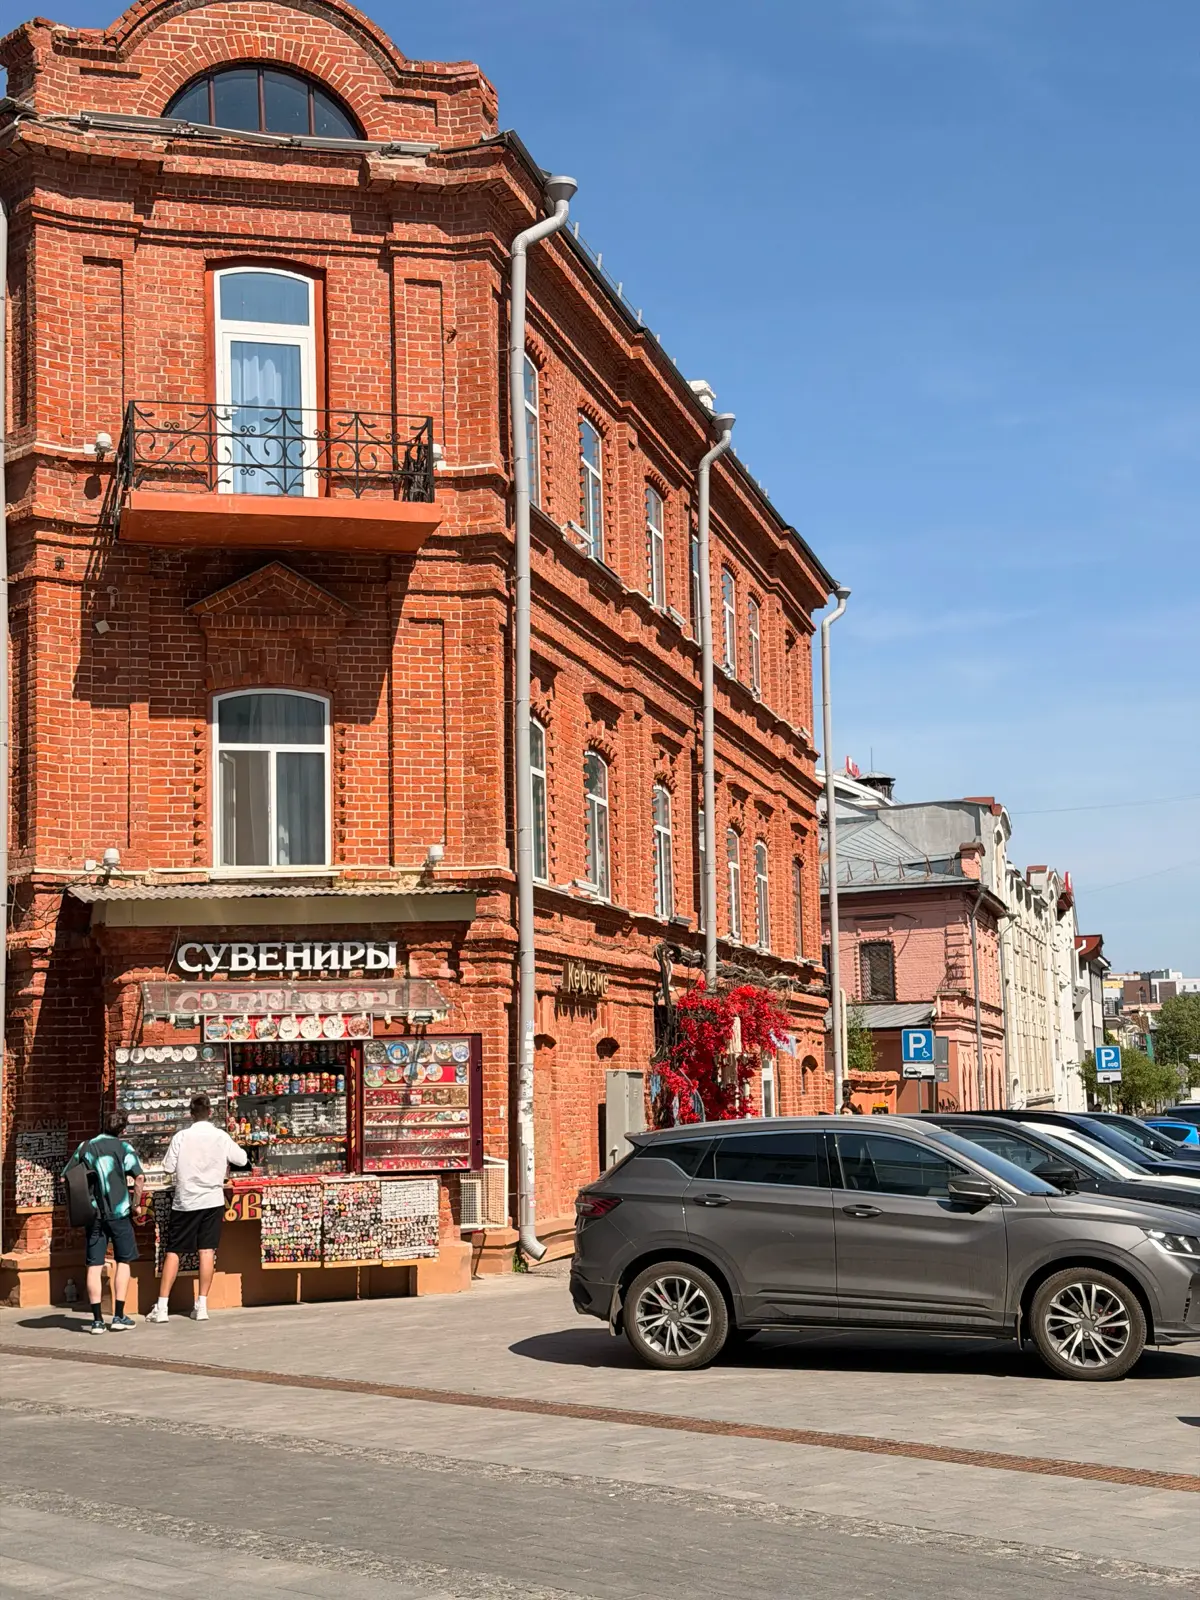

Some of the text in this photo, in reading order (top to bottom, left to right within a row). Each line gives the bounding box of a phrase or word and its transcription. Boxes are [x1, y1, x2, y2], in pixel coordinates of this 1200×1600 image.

[177, 942, 398, 972] СУВЕНИРЫ
[908, 1033, 926, 1058] P
[1101, 1049, 1115, 1068] P
